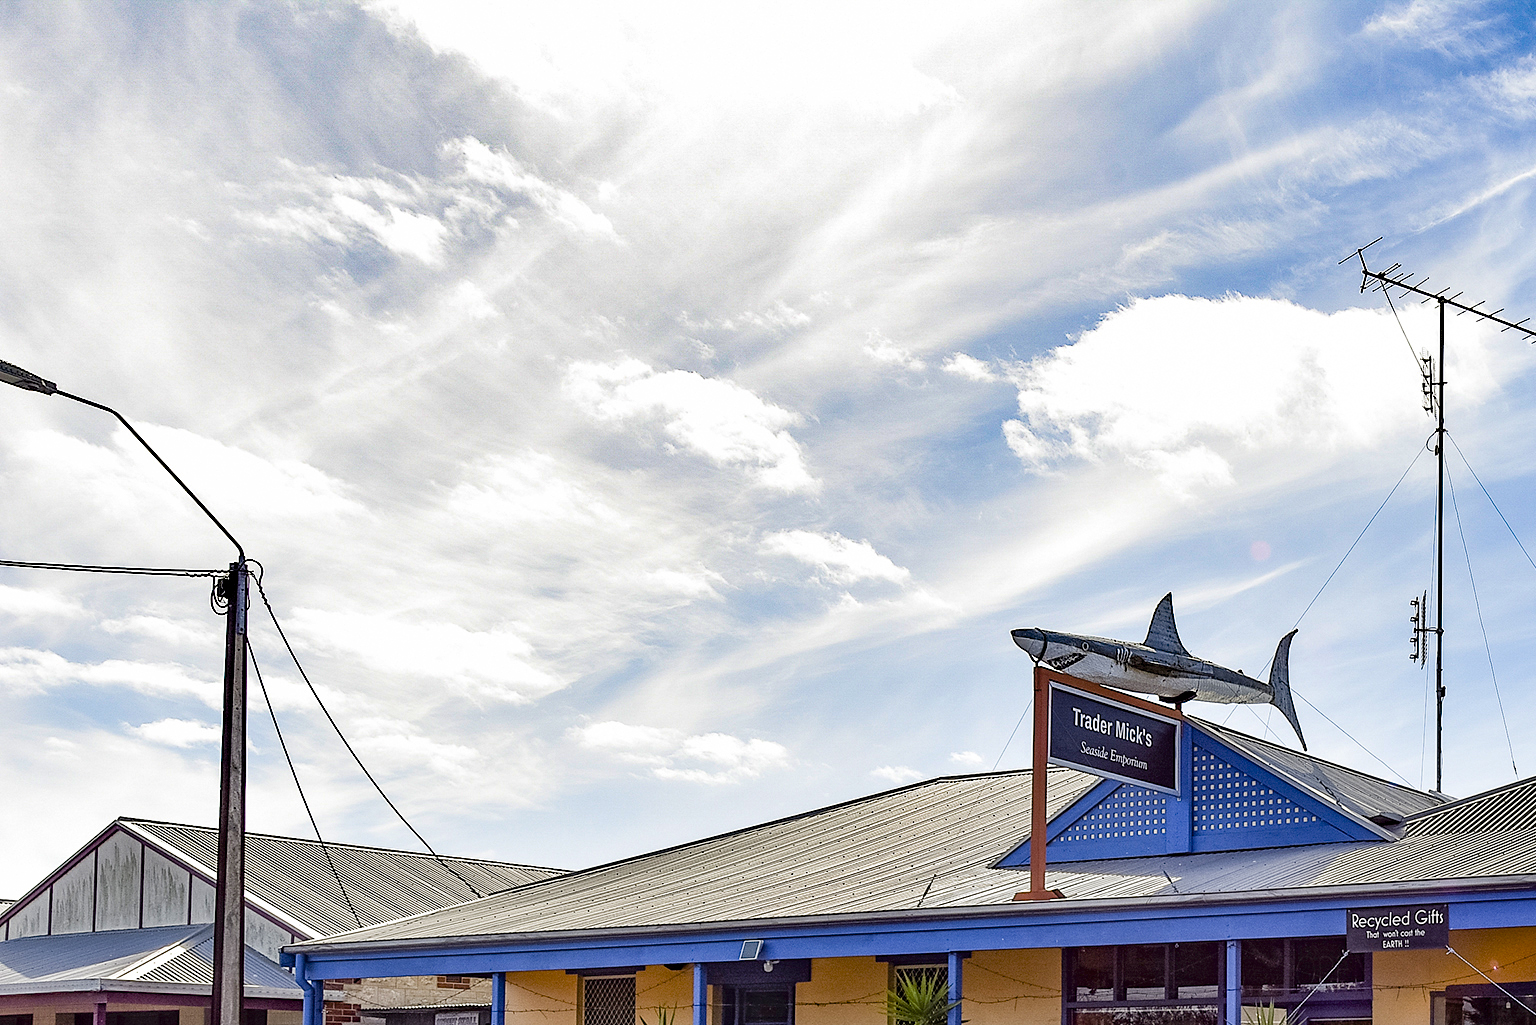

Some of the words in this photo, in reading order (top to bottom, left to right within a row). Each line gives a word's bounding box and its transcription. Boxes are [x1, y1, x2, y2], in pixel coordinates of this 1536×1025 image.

[1072, 707, 1113, 736] Trader
[1115, 720, 1153, 748] Mick's
[1080, 740, 1109, 760] Seaside
[1109, 748, 1148, 771] Emporium
[1351, 911, 1411, 931] Recycled
[1414, 908, 1444, 925] Gifts
[1366, 930, 1380, 939] That
[1400, 929, 1414, 938] cost
[1414, 928, 1426, 937] the
[1382, 940, 1403, 949] EARTH
